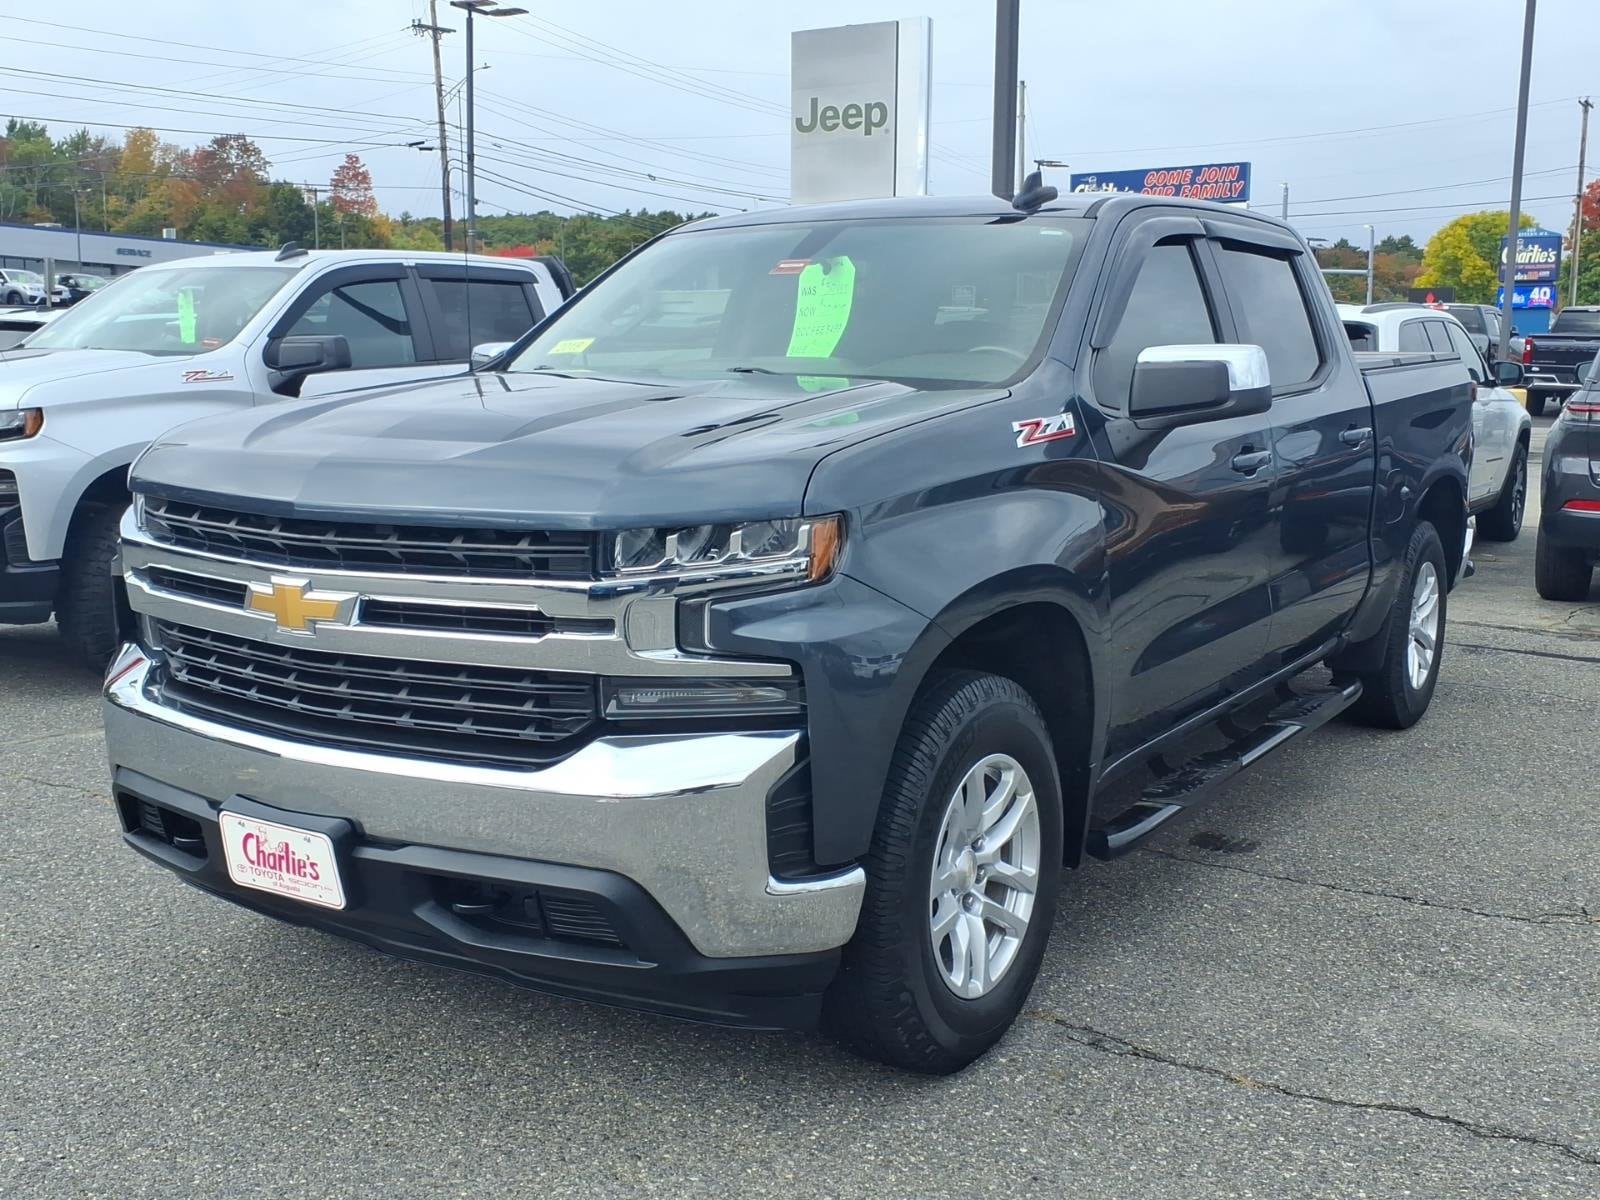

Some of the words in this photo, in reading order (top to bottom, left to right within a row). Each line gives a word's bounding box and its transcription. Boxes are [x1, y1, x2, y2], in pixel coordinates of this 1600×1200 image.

[795, 97, 888, 136] Jeep
[1144, 168, 1194, 186] COME
[1196, 165, 1240, 183] JOIN
[1180, 181, 1244, 200] FAMILY
[801, 286, 817, 297] WAS
[1529, 287, 1551, 300] 40
[1011, 411, 1076, 449] Z71
[242, 831, 320, 881] Charlie's
[249, 866, 285, 882] TOYOTA
